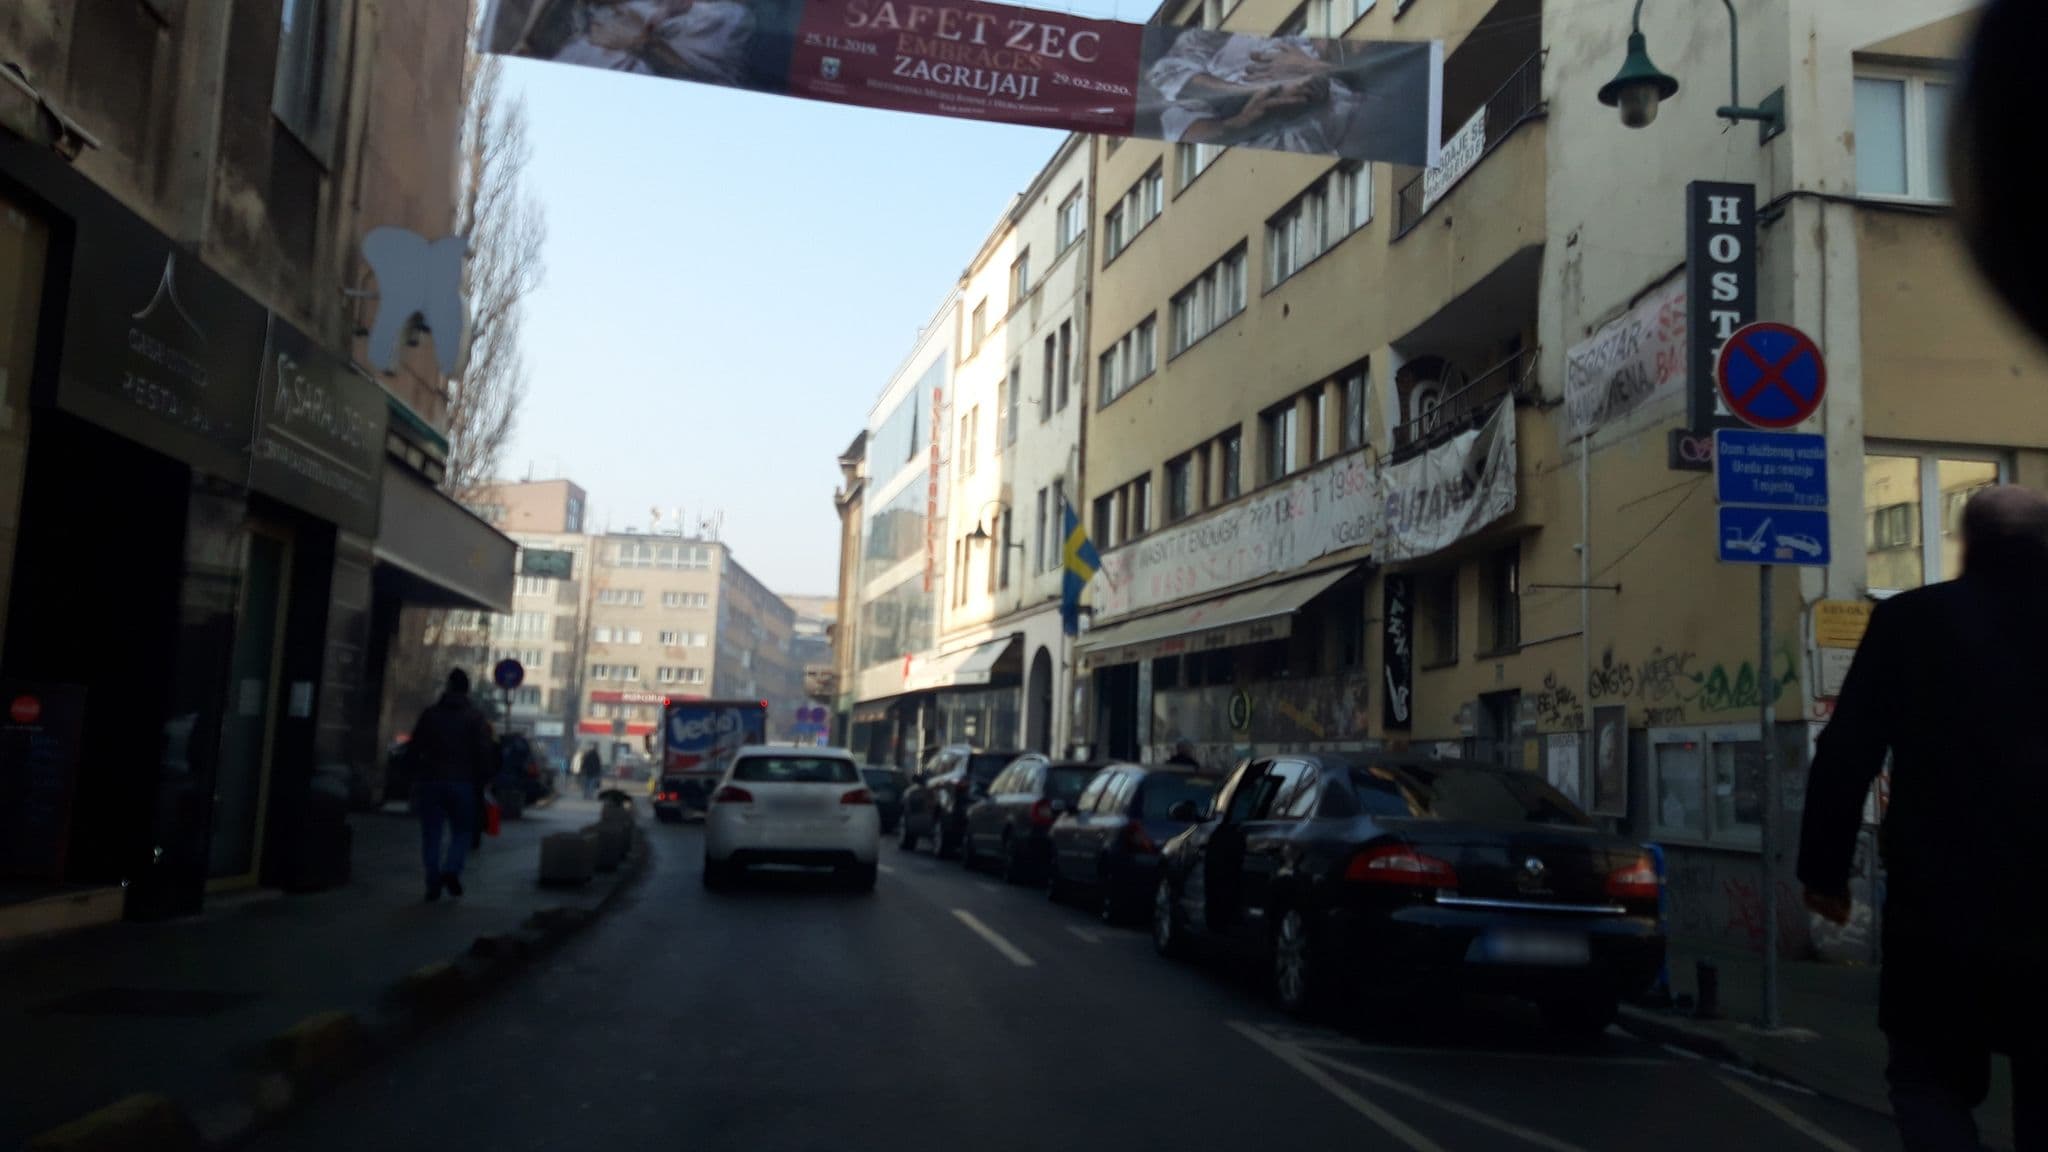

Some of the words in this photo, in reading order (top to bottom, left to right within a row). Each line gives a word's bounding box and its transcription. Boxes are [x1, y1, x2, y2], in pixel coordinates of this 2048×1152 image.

[845, 0, 997, 45] SAFET
[1004, 19, 1100, 63] ZEC
[897, 32, 1044, 72] EMBRACES
[893, 54, 1040, 101] ZAGRLJAJI
[1051, 71, 1132, 97] 29.02.2020.
[1707, 196, 1741, 416] HOST
